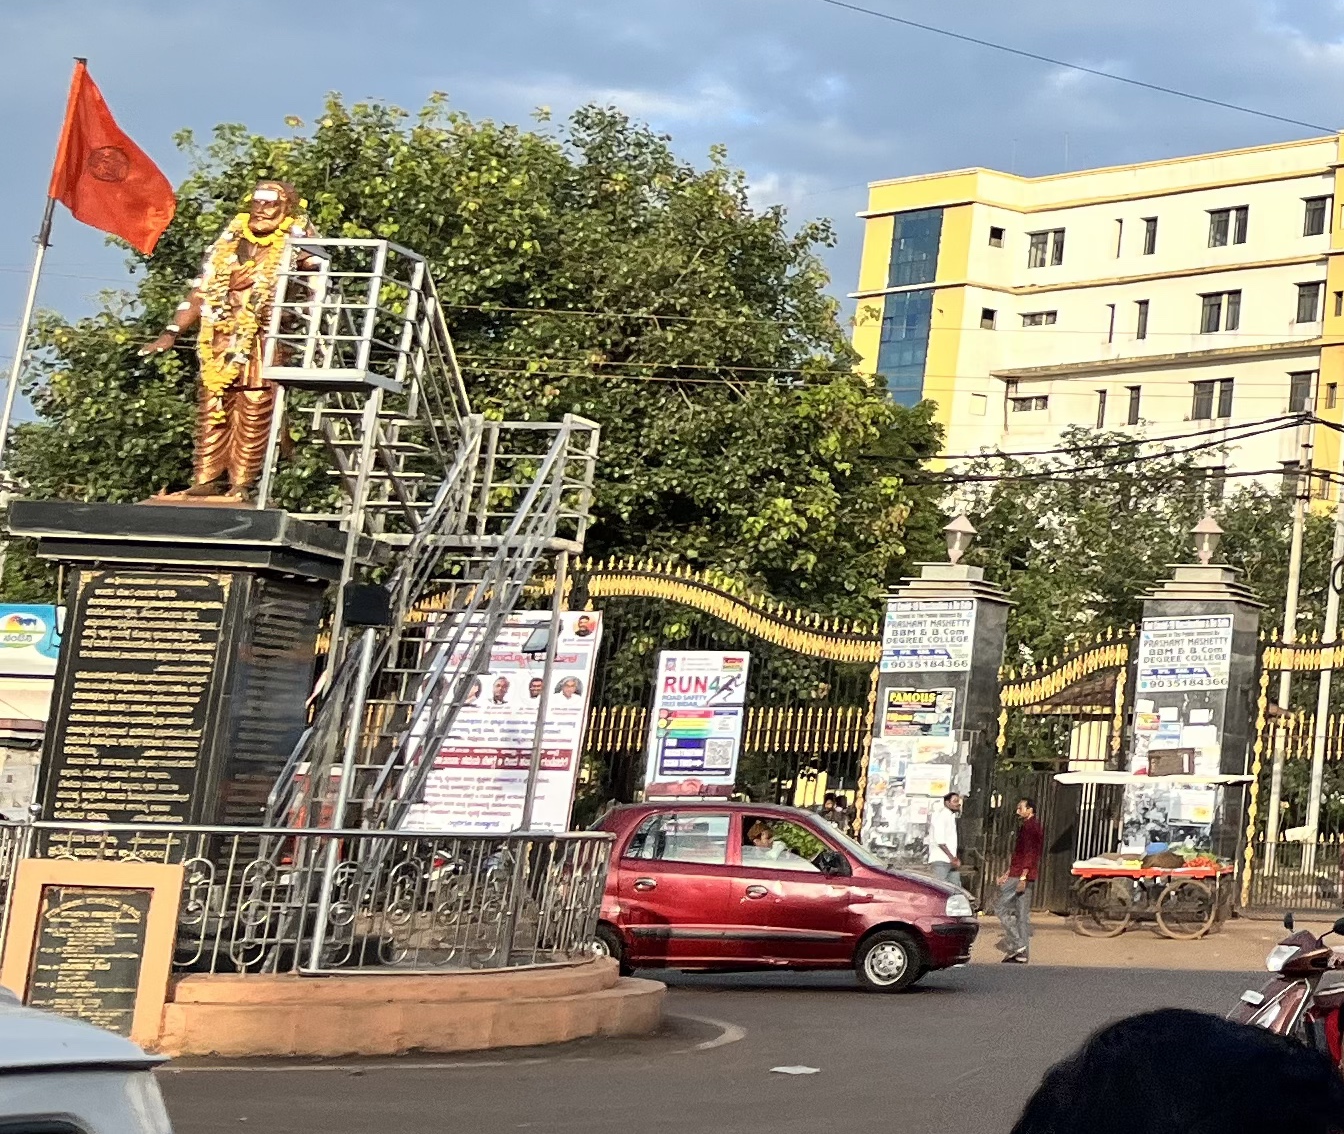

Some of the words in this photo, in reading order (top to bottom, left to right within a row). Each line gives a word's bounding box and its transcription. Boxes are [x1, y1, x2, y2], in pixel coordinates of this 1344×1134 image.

[887, 620, 927, 628] PRASHANT
[1143, 639, 1185, 647] PRASHANT
[1143, 655, 1182, 663] DEGREE
[1185, 654, 1227, 662] COLLEGE
[889, 692, 936, 703] FAMOUS
